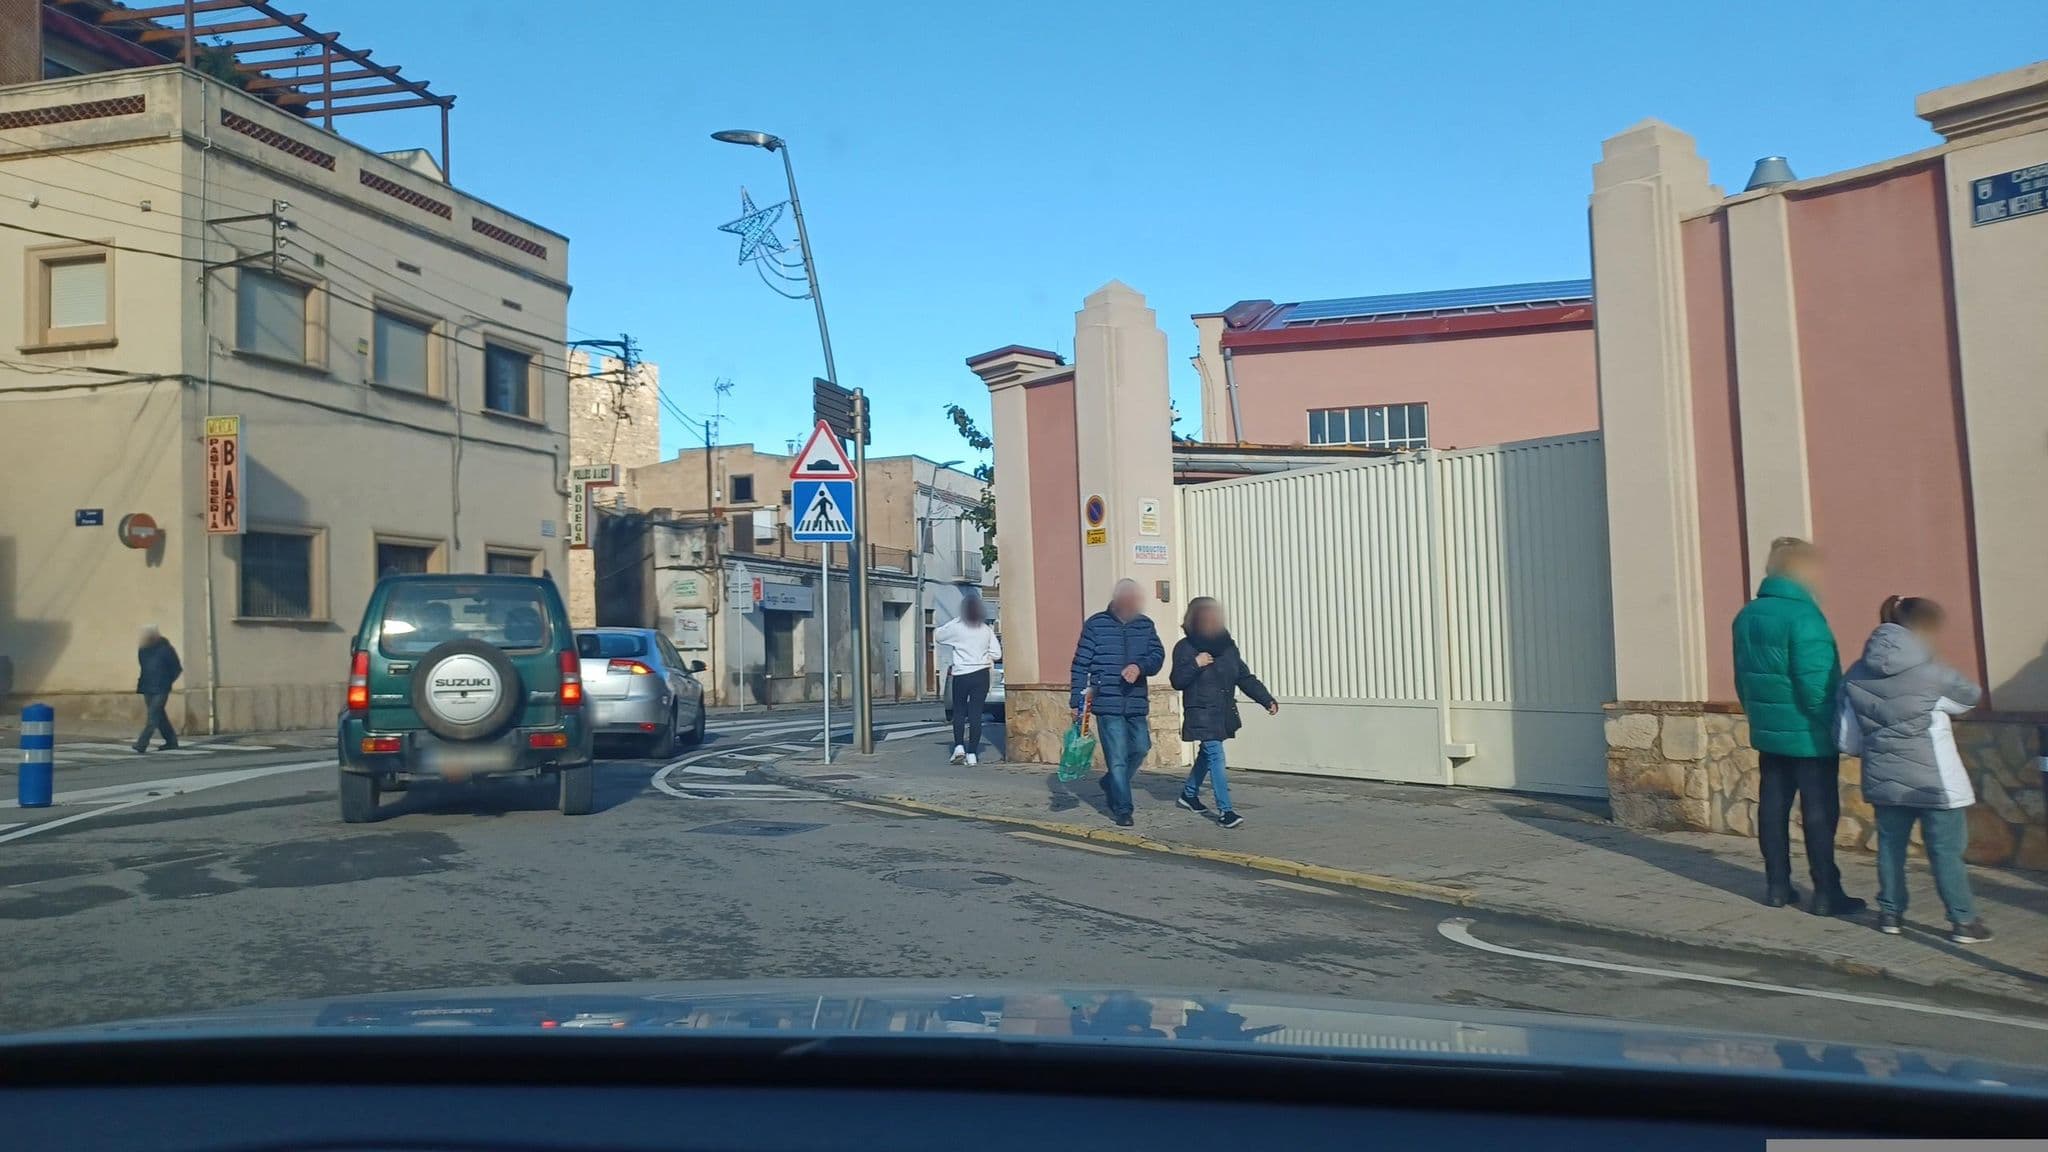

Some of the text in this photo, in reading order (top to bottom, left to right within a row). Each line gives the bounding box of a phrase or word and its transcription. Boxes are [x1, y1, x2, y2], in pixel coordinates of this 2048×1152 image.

[209, 438, 219, 529] PASTISSERIA
[224, 440, 235, 526] BAR
[435, 678, 491, 687] SUZUKI
